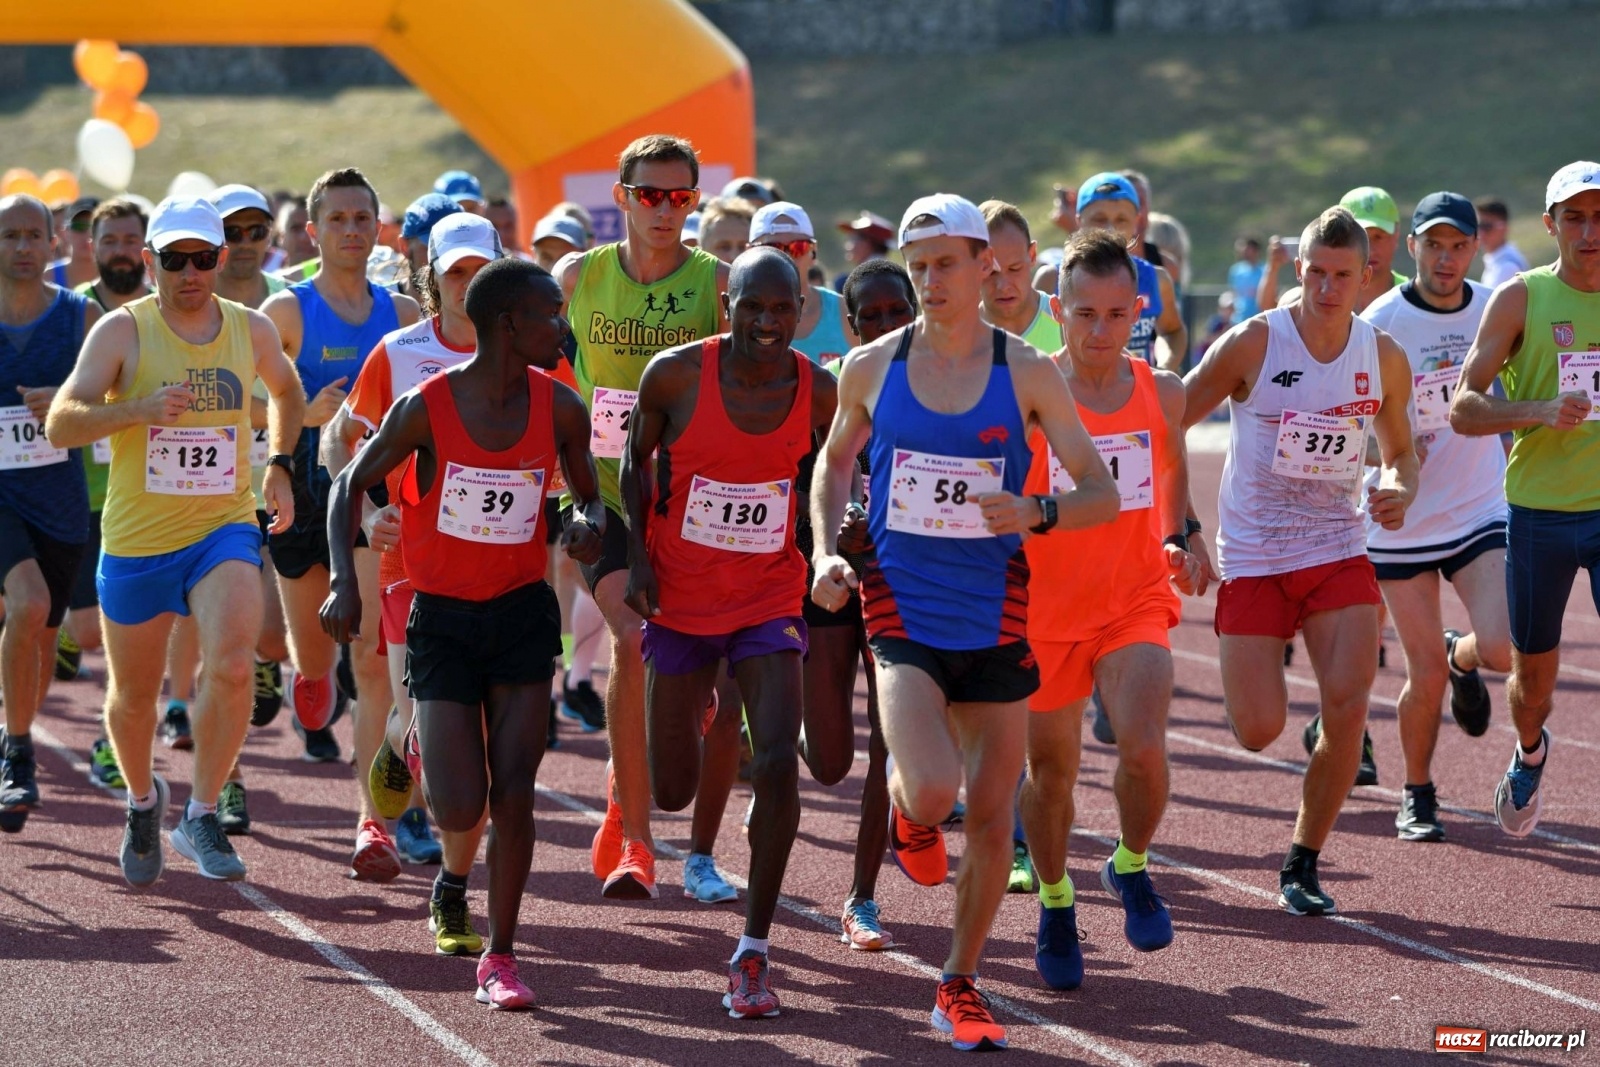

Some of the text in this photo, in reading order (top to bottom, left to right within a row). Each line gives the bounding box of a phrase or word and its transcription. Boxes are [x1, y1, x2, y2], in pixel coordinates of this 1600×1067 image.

[397, 336, 430, 346] deep
[186, 368, 215, 382] THE
[1271, 370, 1304, 387] 4F
[1592, 371, 1600, 392] 1
[1441, 385, 1457, 402] 1
[185, 397, 215, 412] ACE
[1321, 402, 1373, 417] OLSKA
[12, 422, 47, 443] 104
[1305, 432, 1346, 455] 373
[178, 446, 217, 468] 132
[1109, 456, 1118, 480] 1
[482, 490, 514, 515] 39
[934, 479, 968, 505] 58
[722, 502, 768, 525] 130
